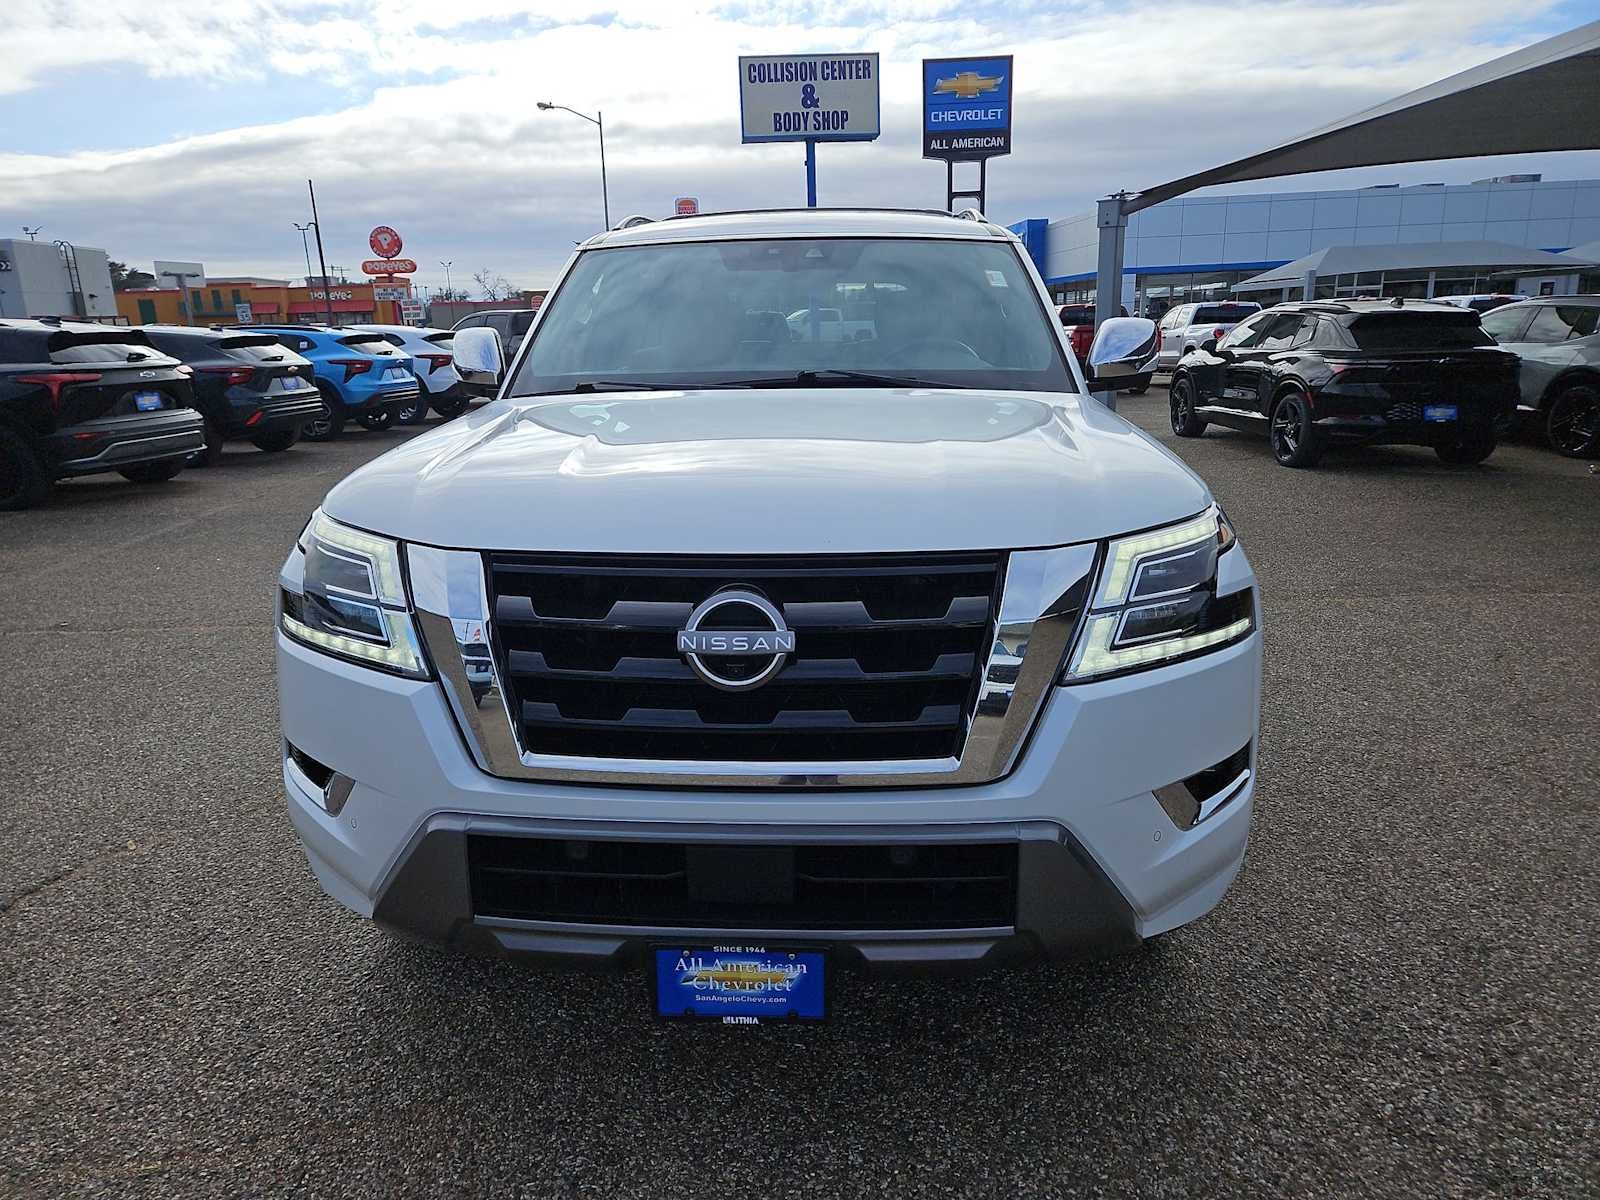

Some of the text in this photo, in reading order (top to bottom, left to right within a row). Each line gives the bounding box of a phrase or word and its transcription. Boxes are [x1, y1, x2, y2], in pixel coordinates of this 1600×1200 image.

[748, 59, 871, 83] COLLISION CENTER
[801, 84, 820, 108] &
[773, 110, 849, 131] BODY SHOP
[931, 109, 1003, 122] CHEVROLET
[930, 137, 1004, 149] ALL AMERICAN
[681, 636, 791, 650] NISSAN
[675, 957, 807, 974] All American
[692, 976, 793, 992] Chevrolet
[695, 994, 787, 1004] SanAngeloChevy.com
[730, 1016, 759, 1025] LITHIA
